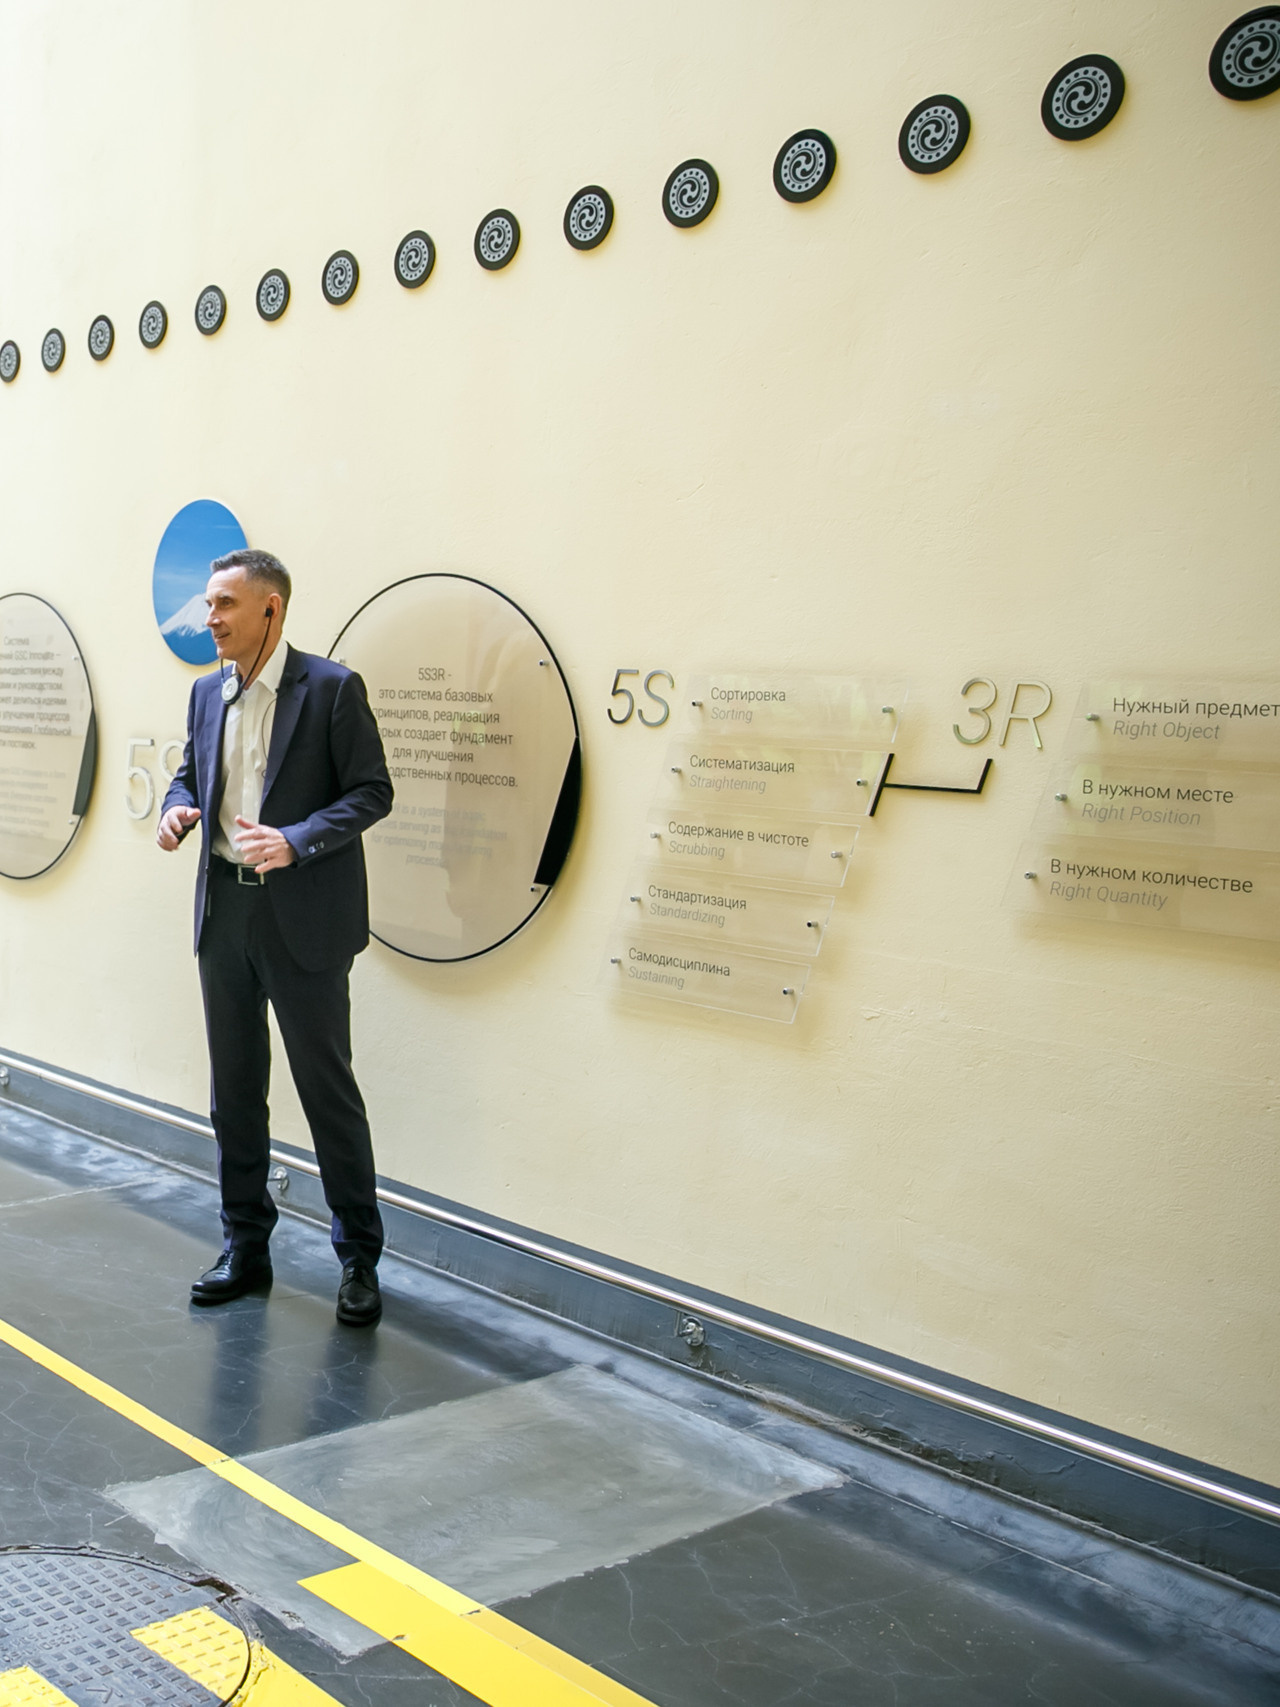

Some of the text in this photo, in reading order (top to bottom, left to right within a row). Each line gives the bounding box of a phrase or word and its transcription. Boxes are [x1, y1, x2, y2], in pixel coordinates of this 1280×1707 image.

[418, 667, 445, 681] 5S3R
[379, 688, 493, 703] это система базовых
[607, 669, 675, 727] 5S
[710, 687, 786, 703] Сортировка
[434, 710, 500, 724] реализация
[711, 707, 753, 724] Sorting
[953, 677, 1053, 749] 3R
[1113, 697, 1280, 719] Нужный предмет
[404, 729, 447, 741] создает
[450, 729, 514, 745] фундамент
[1113, 720, 1220, 742] Right Object
[392, 748, 474, 763] для улучшения
[690, 755, 795, 774] Систематизация
[455, 771, 518, 788] процессов.
[690, 775, 766, 794] Straightening
[1082, 779, 1234, 803] В нужном месте
[1082, 803, 1201, 826] Right Position
[668, 821, 809, 848] Содержание в чистоте
[669, 841, 725, 860] Scrubbing
[1050, 859, 1253, 893] В нужном количестве
[648, 885, 747, 910] Стандартизация
[1050, 882, 1168, 912] Right Quantity
[649, 903, 725, 928] Standardizing
[628, 947, 730, 976] Самодисциплина
[628, 967, 685, 990] Sustaining
